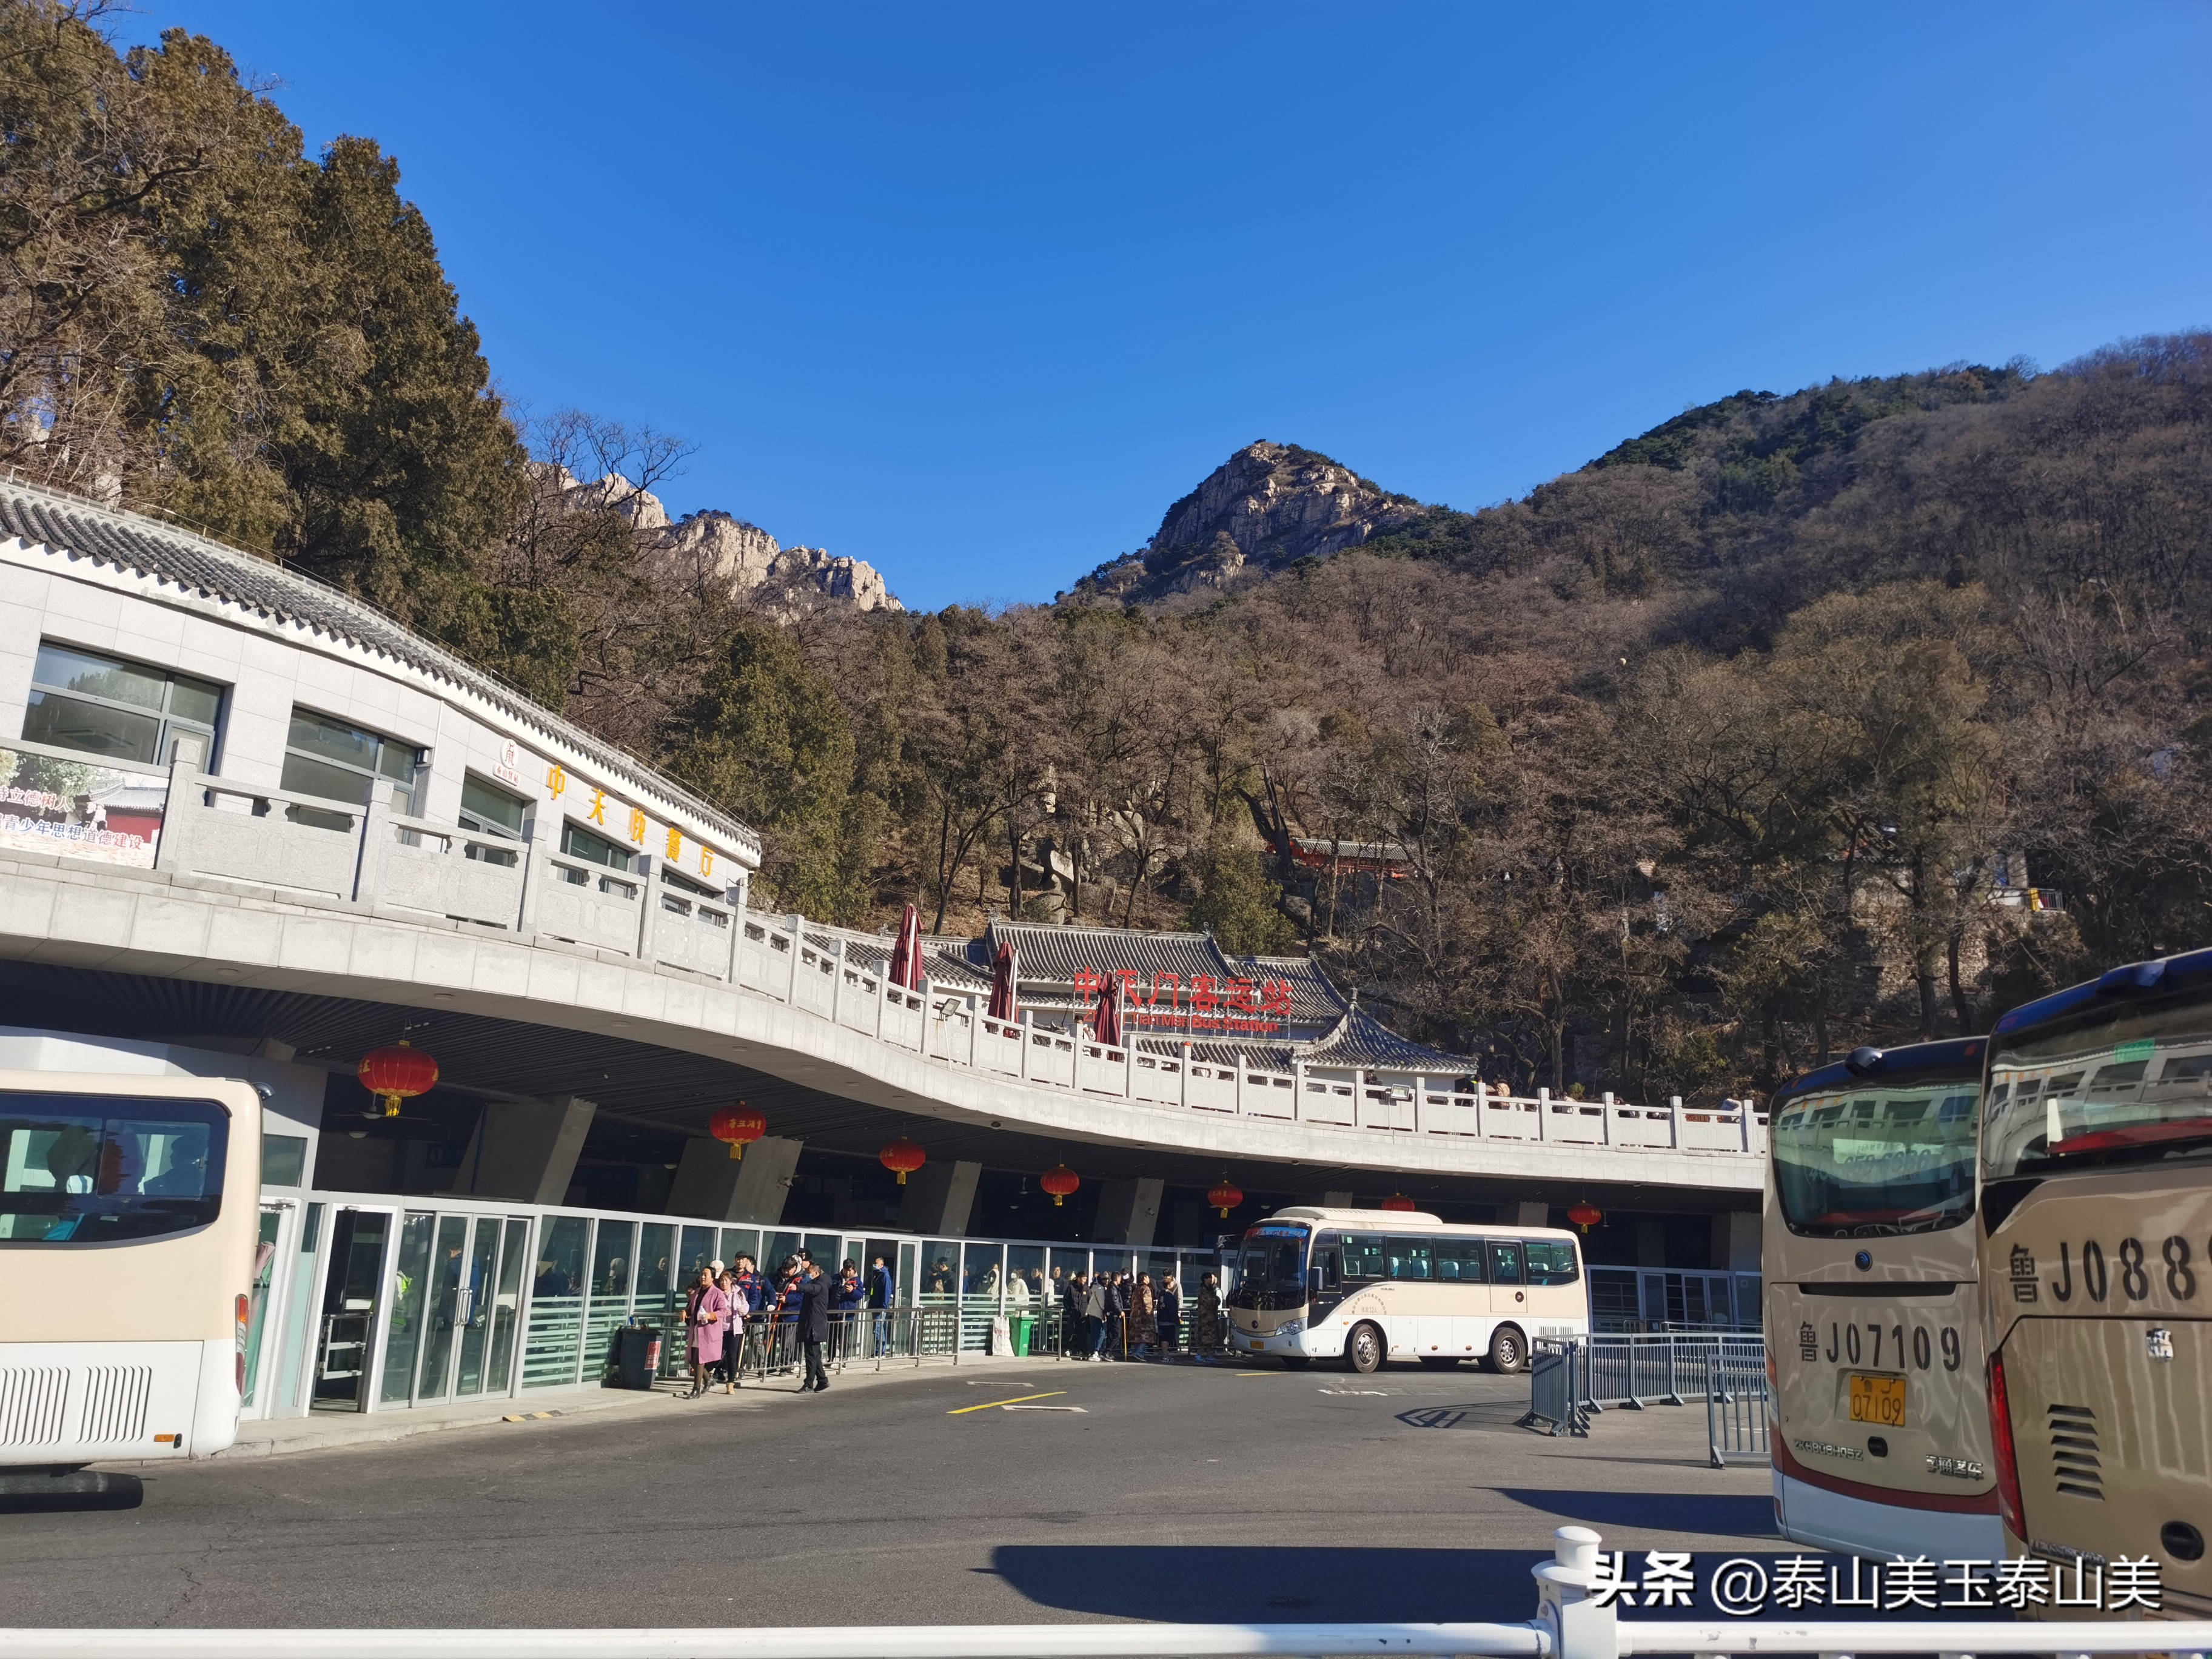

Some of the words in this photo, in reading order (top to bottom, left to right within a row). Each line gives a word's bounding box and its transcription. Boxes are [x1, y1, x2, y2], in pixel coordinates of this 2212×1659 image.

[0, 813, 144, 850] 青少年思想道德建设
[546, 765, 716, 877] 中天快餐厅
[1074, 966, 1293, 1014] 中天门客运站
[1161, 1013, 1190, 1027] Men
[1192, 1014, 1220, 1029] Bus
[1222, 1016, 1278, 1033] Station
[2009, 1235, 2212, 1303] 鲁J088
[1799, 1321, 1961, 1372] 鲁J07109
[1852, 1393, 1902, 1422] 07109
[1926, 1453, 1985, 1480] 宇通客车
